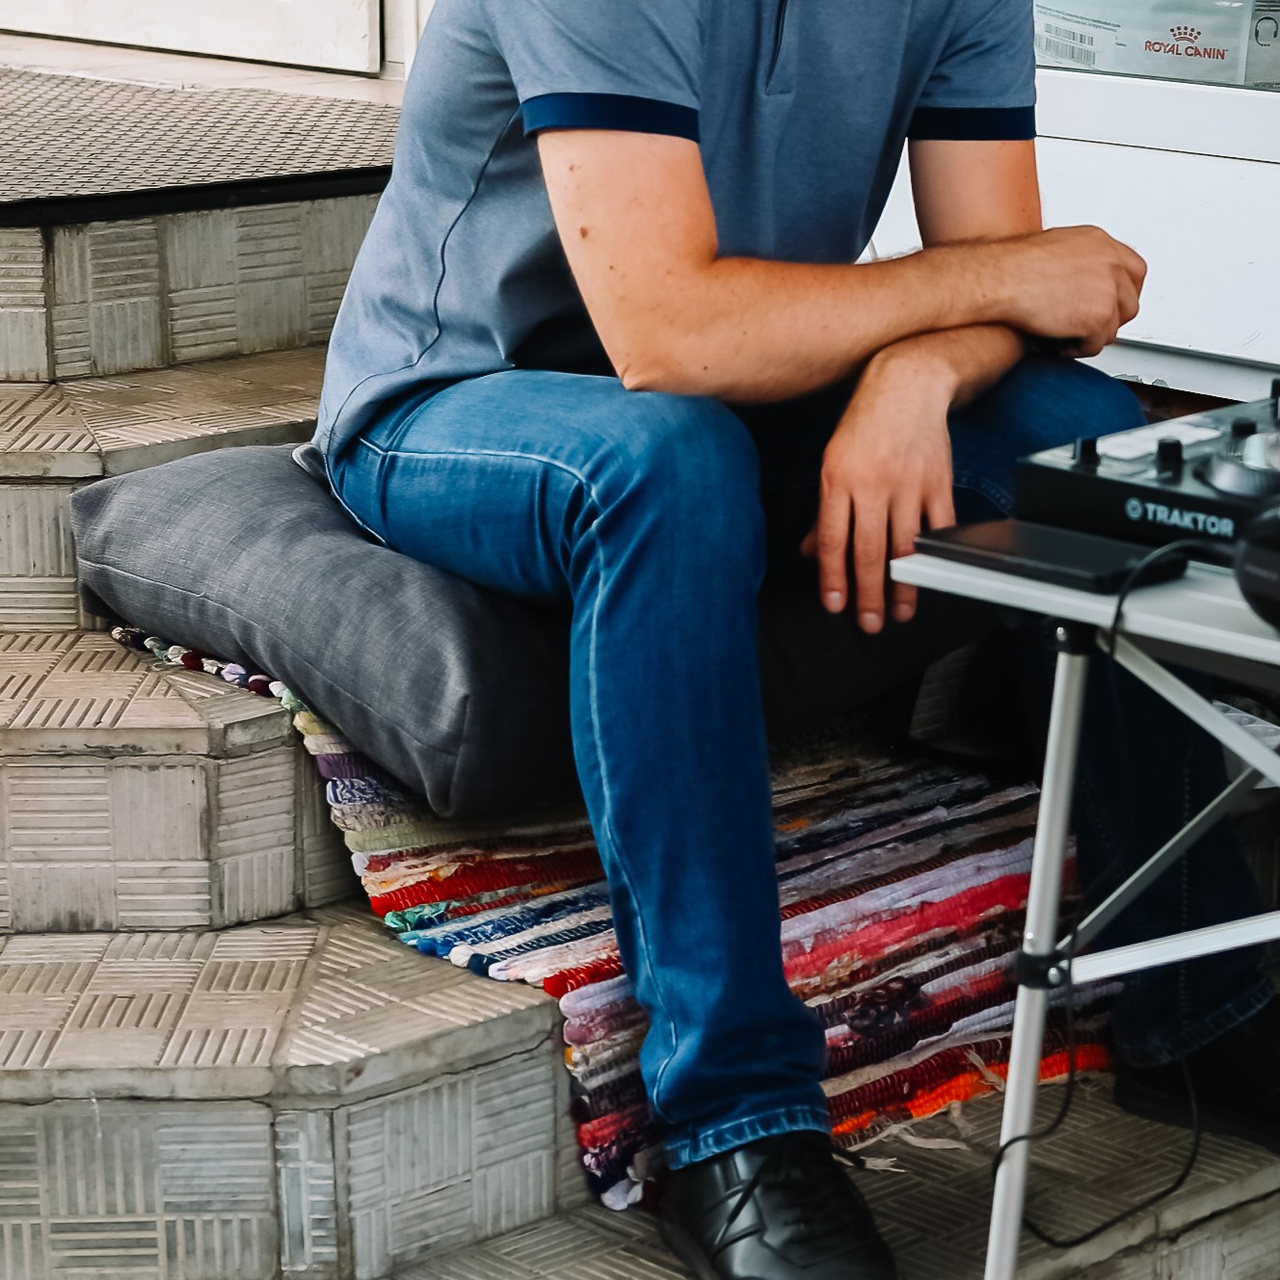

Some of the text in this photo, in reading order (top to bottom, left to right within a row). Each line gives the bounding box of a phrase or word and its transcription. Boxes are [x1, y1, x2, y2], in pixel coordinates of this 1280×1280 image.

[1144, 40, 1226, 60] ROYAL CANIN
[1144, 502, 1235, 538] TRAKTOR
